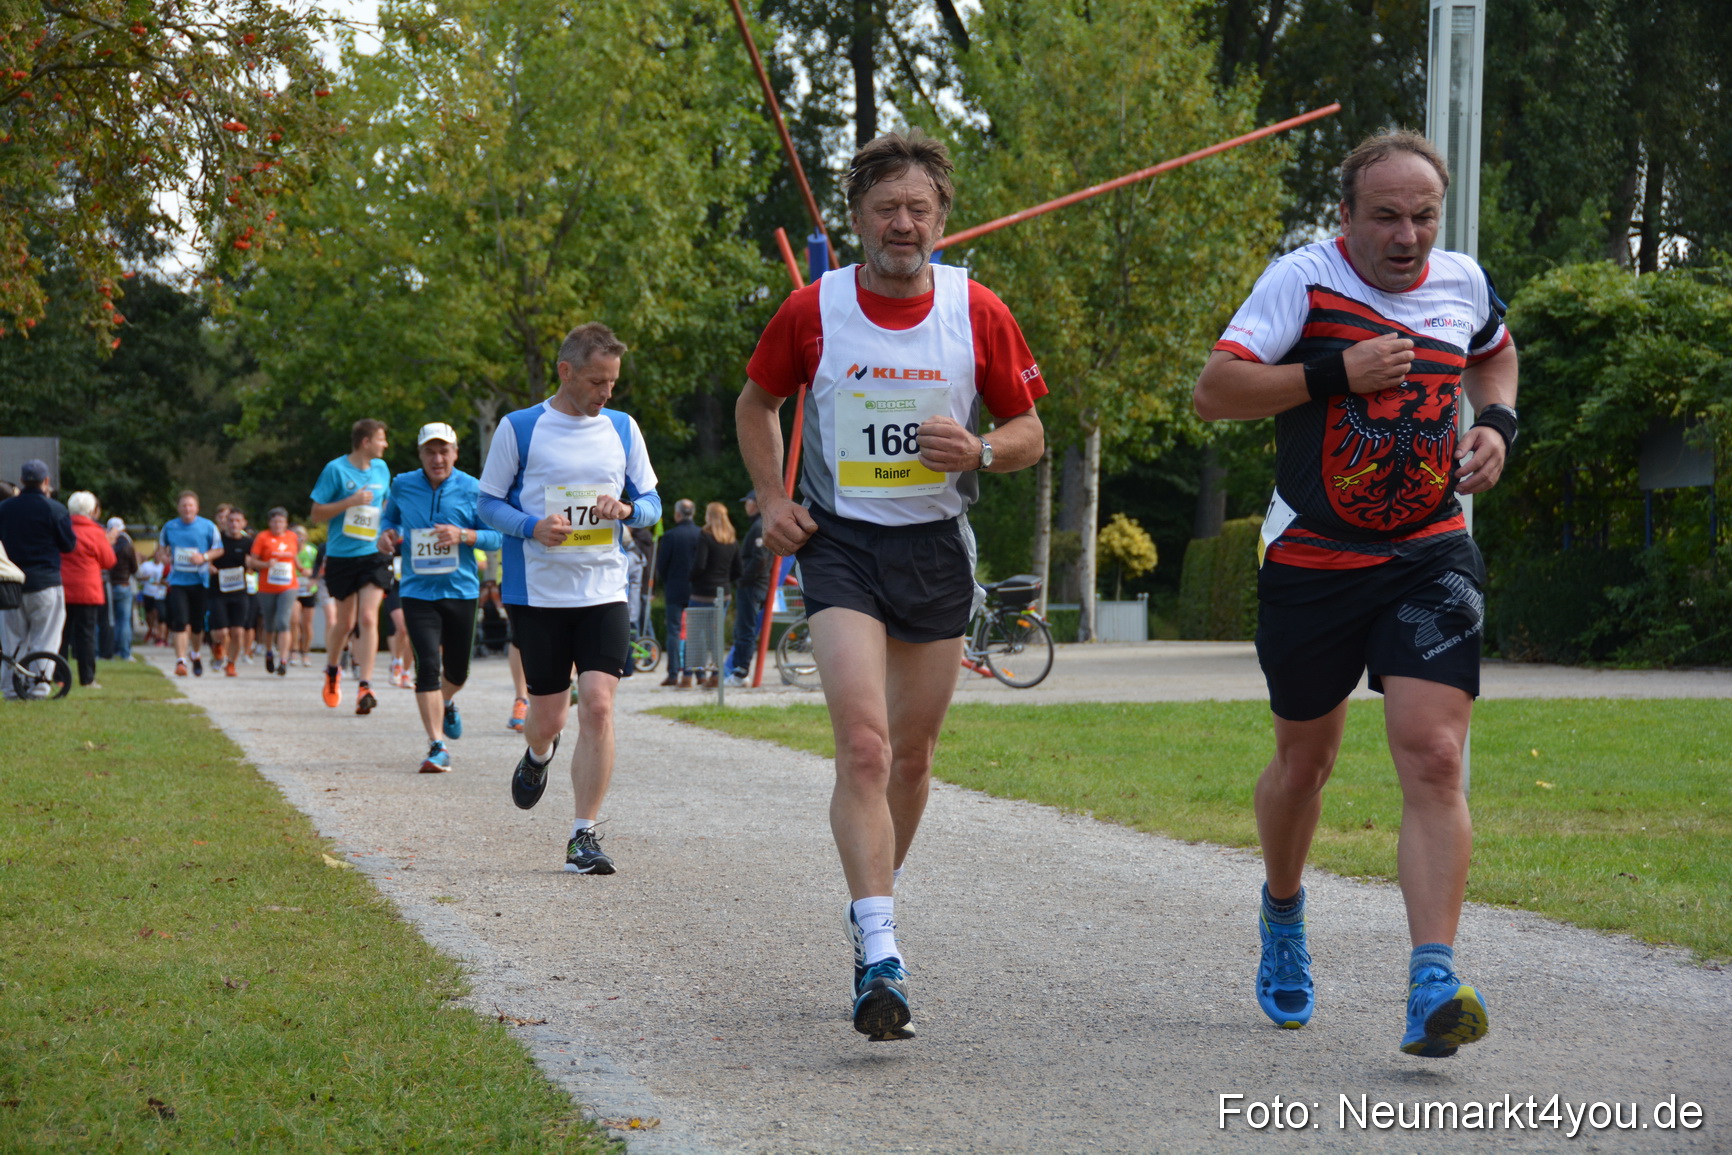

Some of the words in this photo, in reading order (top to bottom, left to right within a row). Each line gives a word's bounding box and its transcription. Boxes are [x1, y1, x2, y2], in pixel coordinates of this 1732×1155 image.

[872, 367, 948, 382] KLEBL
[876, 399, 917, 410] BOCK
[862, 422, 921, 456] 168
[875, 467, 911, 479] Rainer
[563, 505, 600, 526] 176
[573, 533, 591, 541] Sven
[1422, 635, 1462, 660] UNDER
